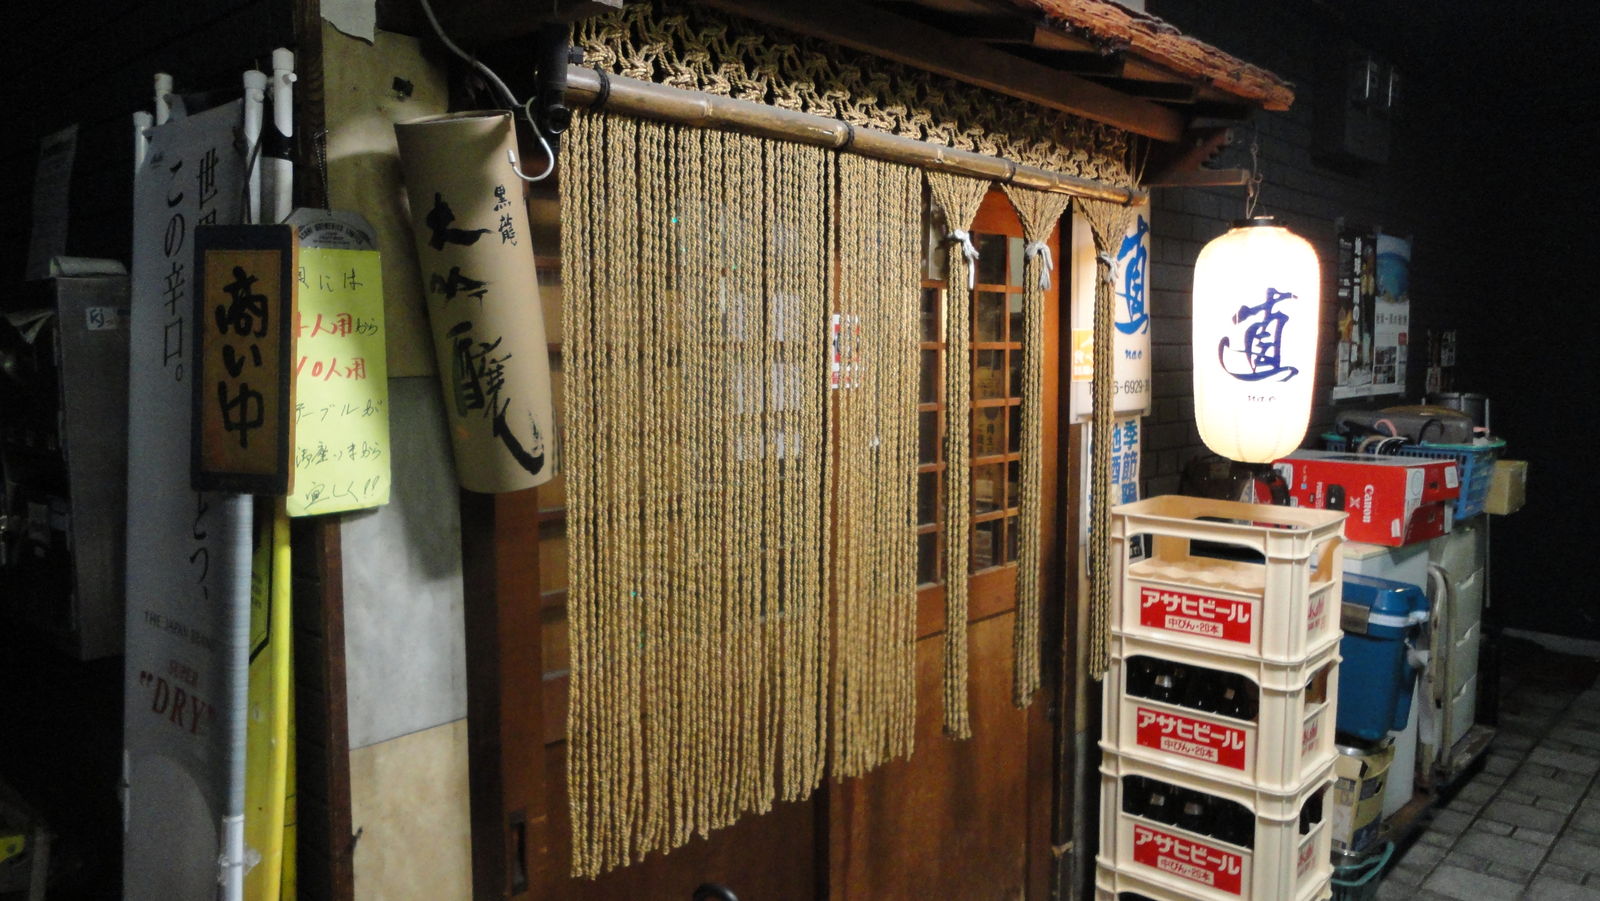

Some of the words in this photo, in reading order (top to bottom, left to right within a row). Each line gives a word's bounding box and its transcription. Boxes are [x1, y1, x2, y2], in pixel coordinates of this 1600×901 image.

[163, 159, 184, 382] この辛口。
[214, 265, 268, 447] 商い中
[1217, 287, 1299, 382] 直
[1362, 483, 1374, 523] Canon
[1142, 590, 1250, 623] アサヒビール
[1138, 710, 1244, 750] アサヒビール
[1134, 828, 1240, 875] アサヒビール
